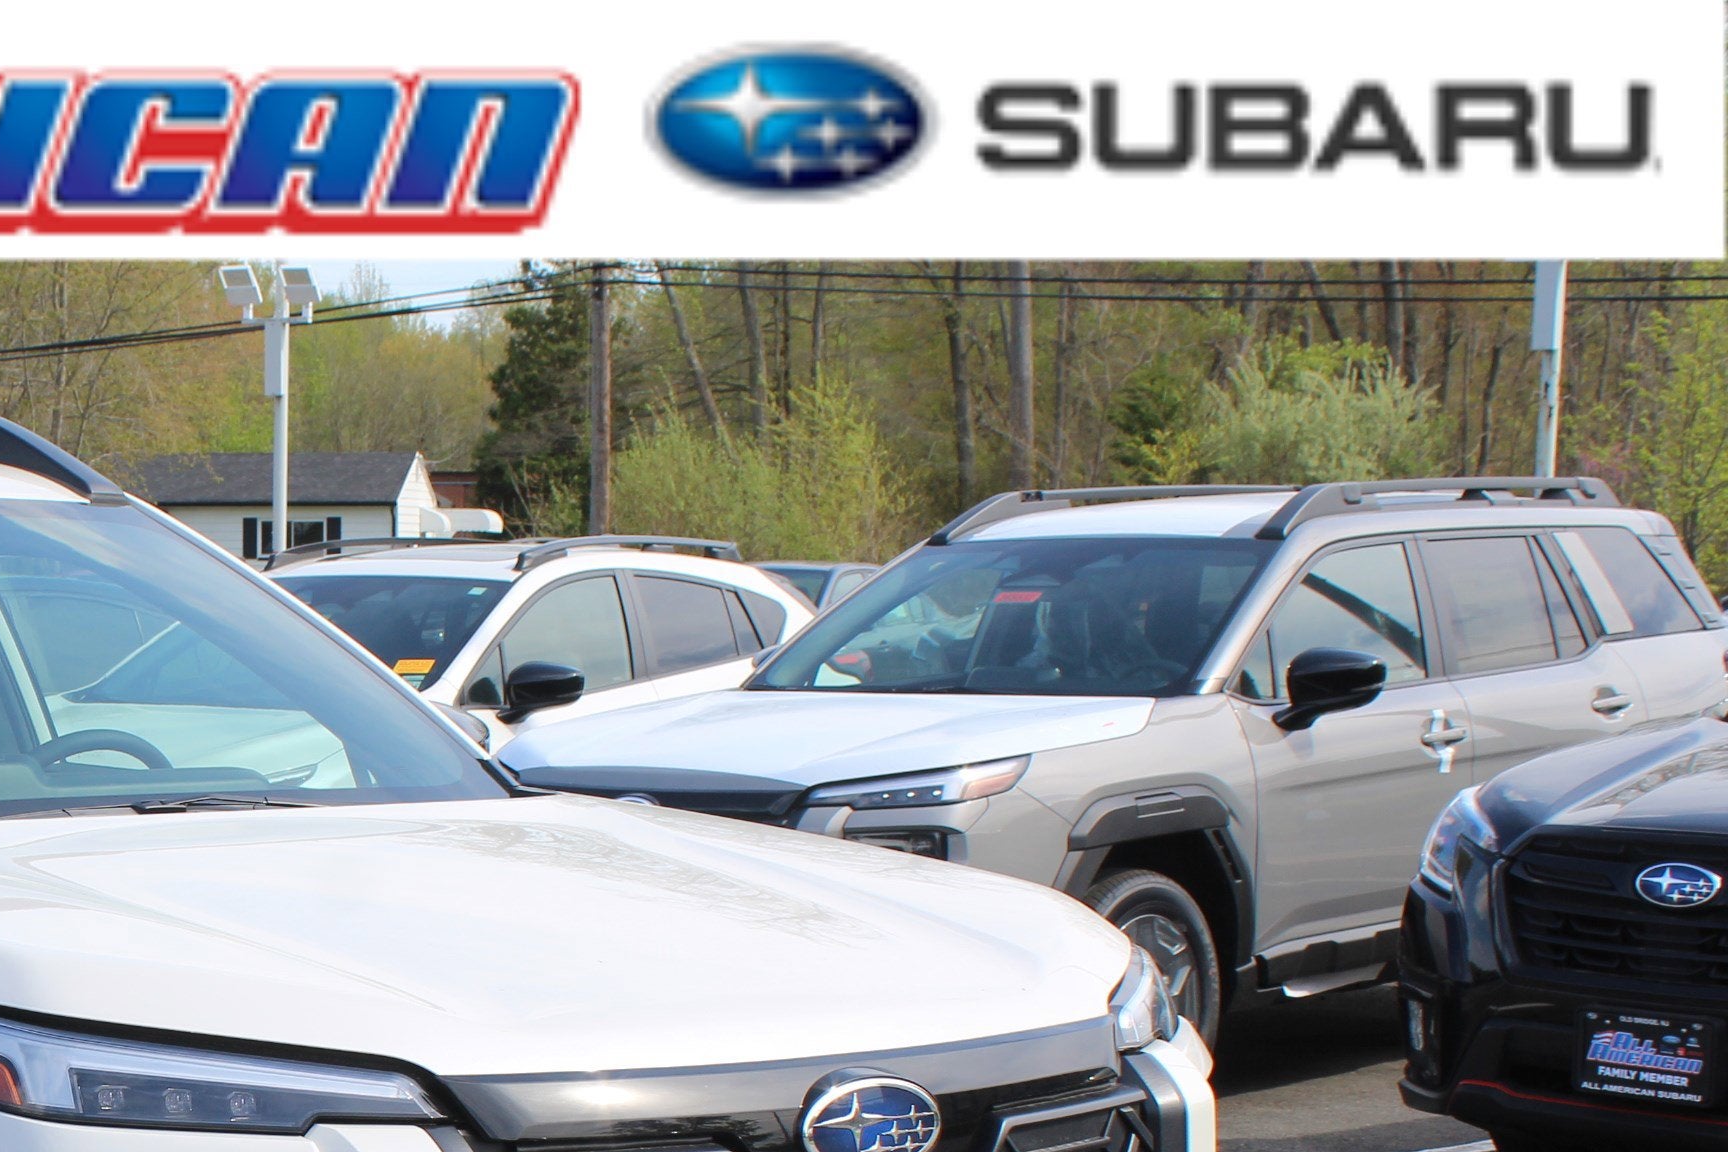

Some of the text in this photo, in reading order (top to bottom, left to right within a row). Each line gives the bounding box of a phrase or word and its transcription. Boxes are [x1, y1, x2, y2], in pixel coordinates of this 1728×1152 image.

[1612, 1031, 1656, 1054] ALL
[1586, 1042, 1702, 1074] AMERICAN
[1598, 1066, 1689, 1087] FAMILY MEMBER
[1581, 1081, 1702, 1102] ALL AMERICAN SUBARU
